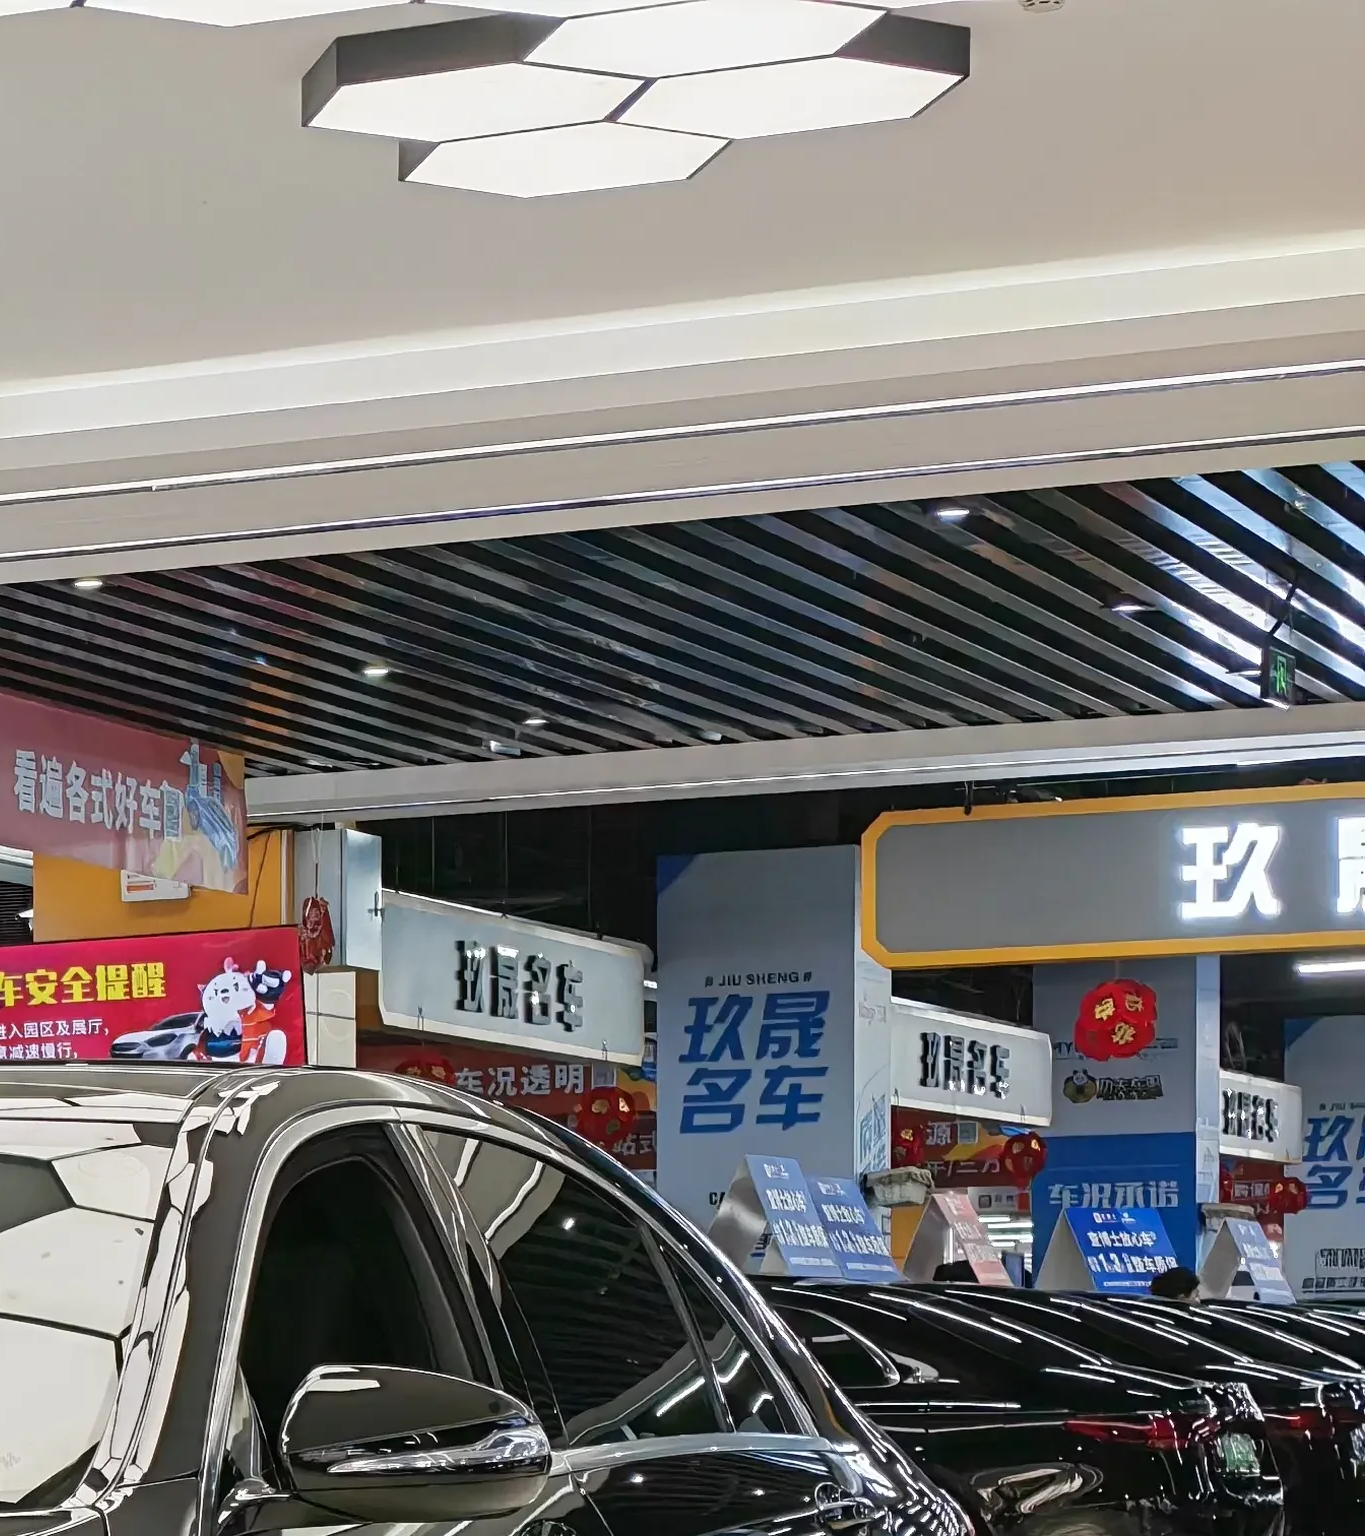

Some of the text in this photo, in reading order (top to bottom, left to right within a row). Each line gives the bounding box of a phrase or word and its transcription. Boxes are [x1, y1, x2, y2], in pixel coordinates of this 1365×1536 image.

[14, 750, 162, 840] 看遍各式好车
[746, 971, 799, 986] SHENG
[678, 990, 831, 1063] 玖晟
[679, 1065, 829, 1134] 名车
[1303, 1114, 1365, 1162] 玖
